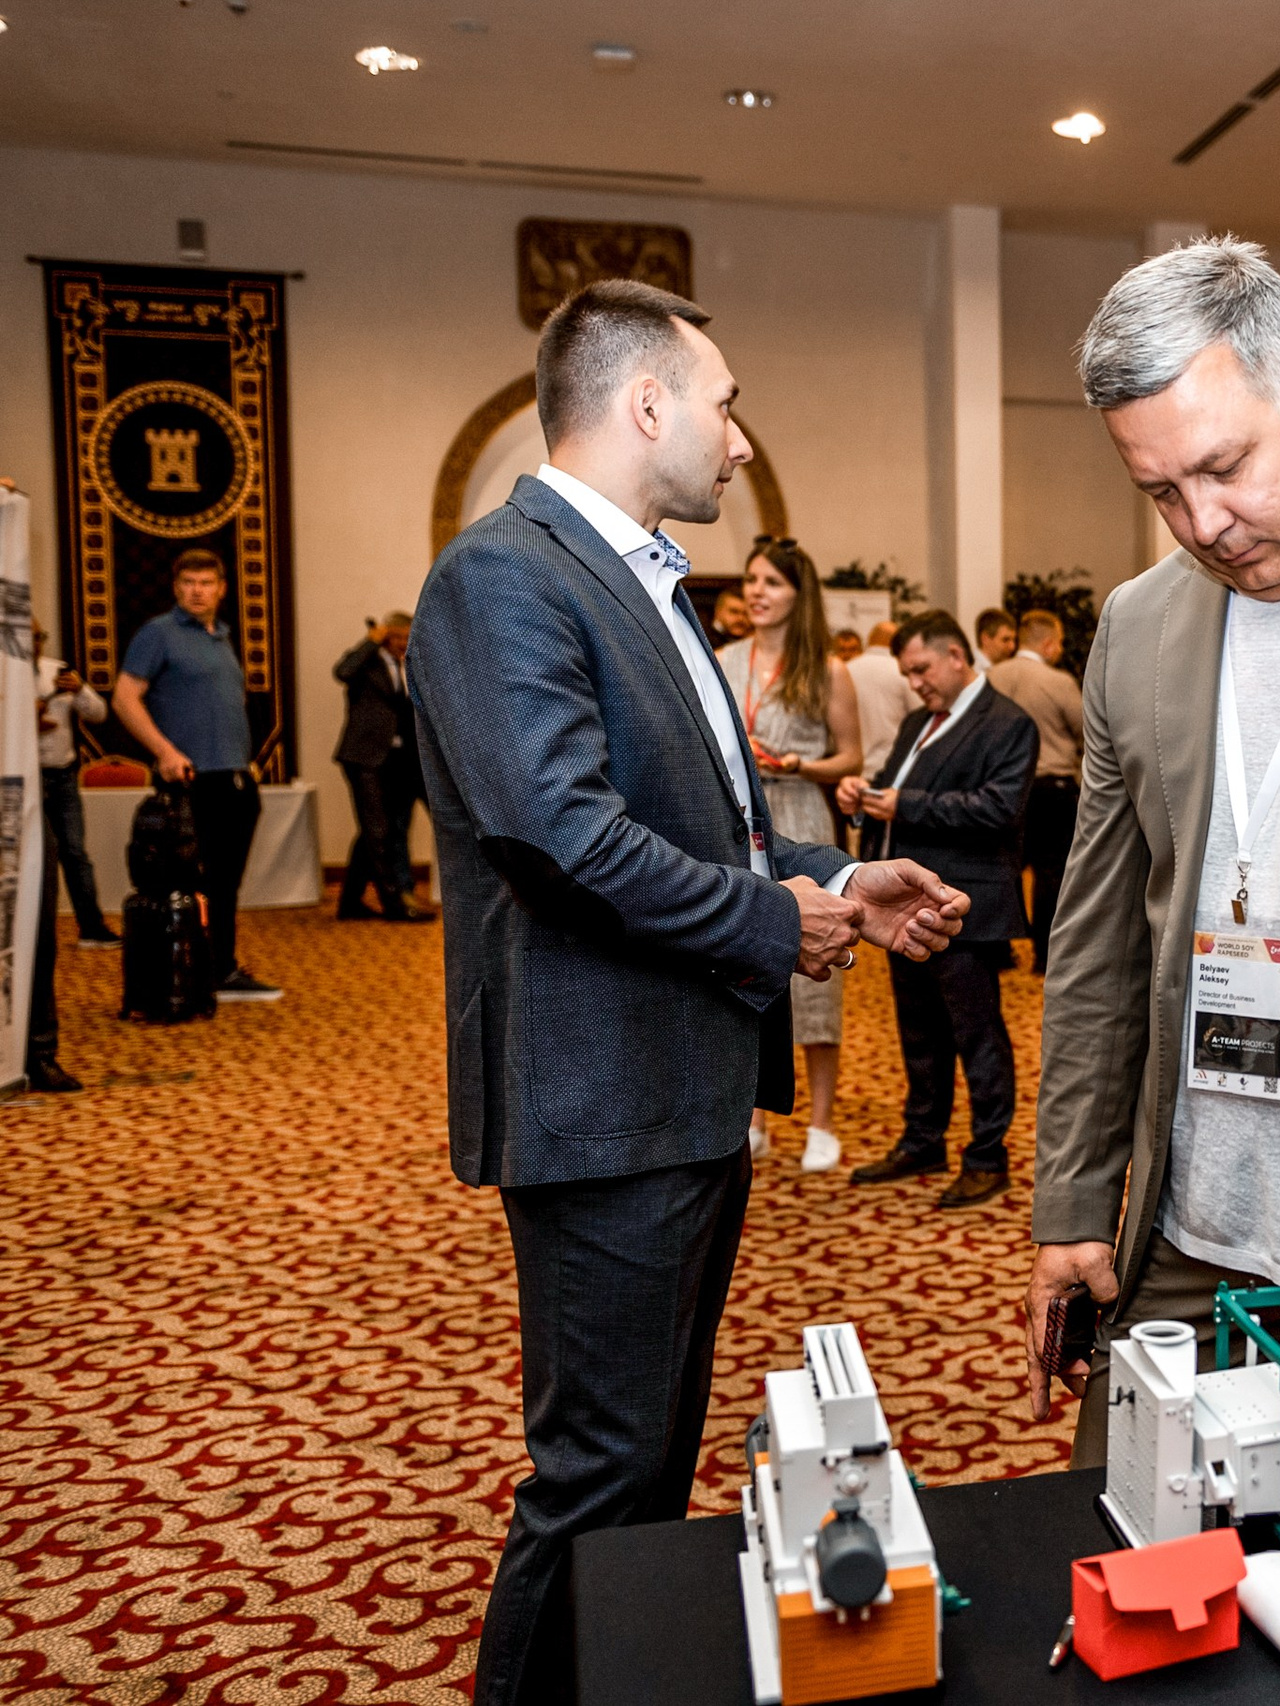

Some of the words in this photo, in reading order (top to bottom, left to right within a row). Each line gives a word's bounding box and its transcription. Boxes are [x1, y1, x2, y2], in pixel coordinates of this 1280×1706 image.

[1217, 950, 1249, 958] RAPESEED
[1200, 963, 1229, 974] Belyaev
[1199, 974, 1229, 986] Aleksey
[1198, 990, 1221, 998] Director
[1229, 993, 1255, 1003] Business
[1198, 998, 1236, 1009] Development
[1241, 1039, 1275, 1050] PROJECTS
